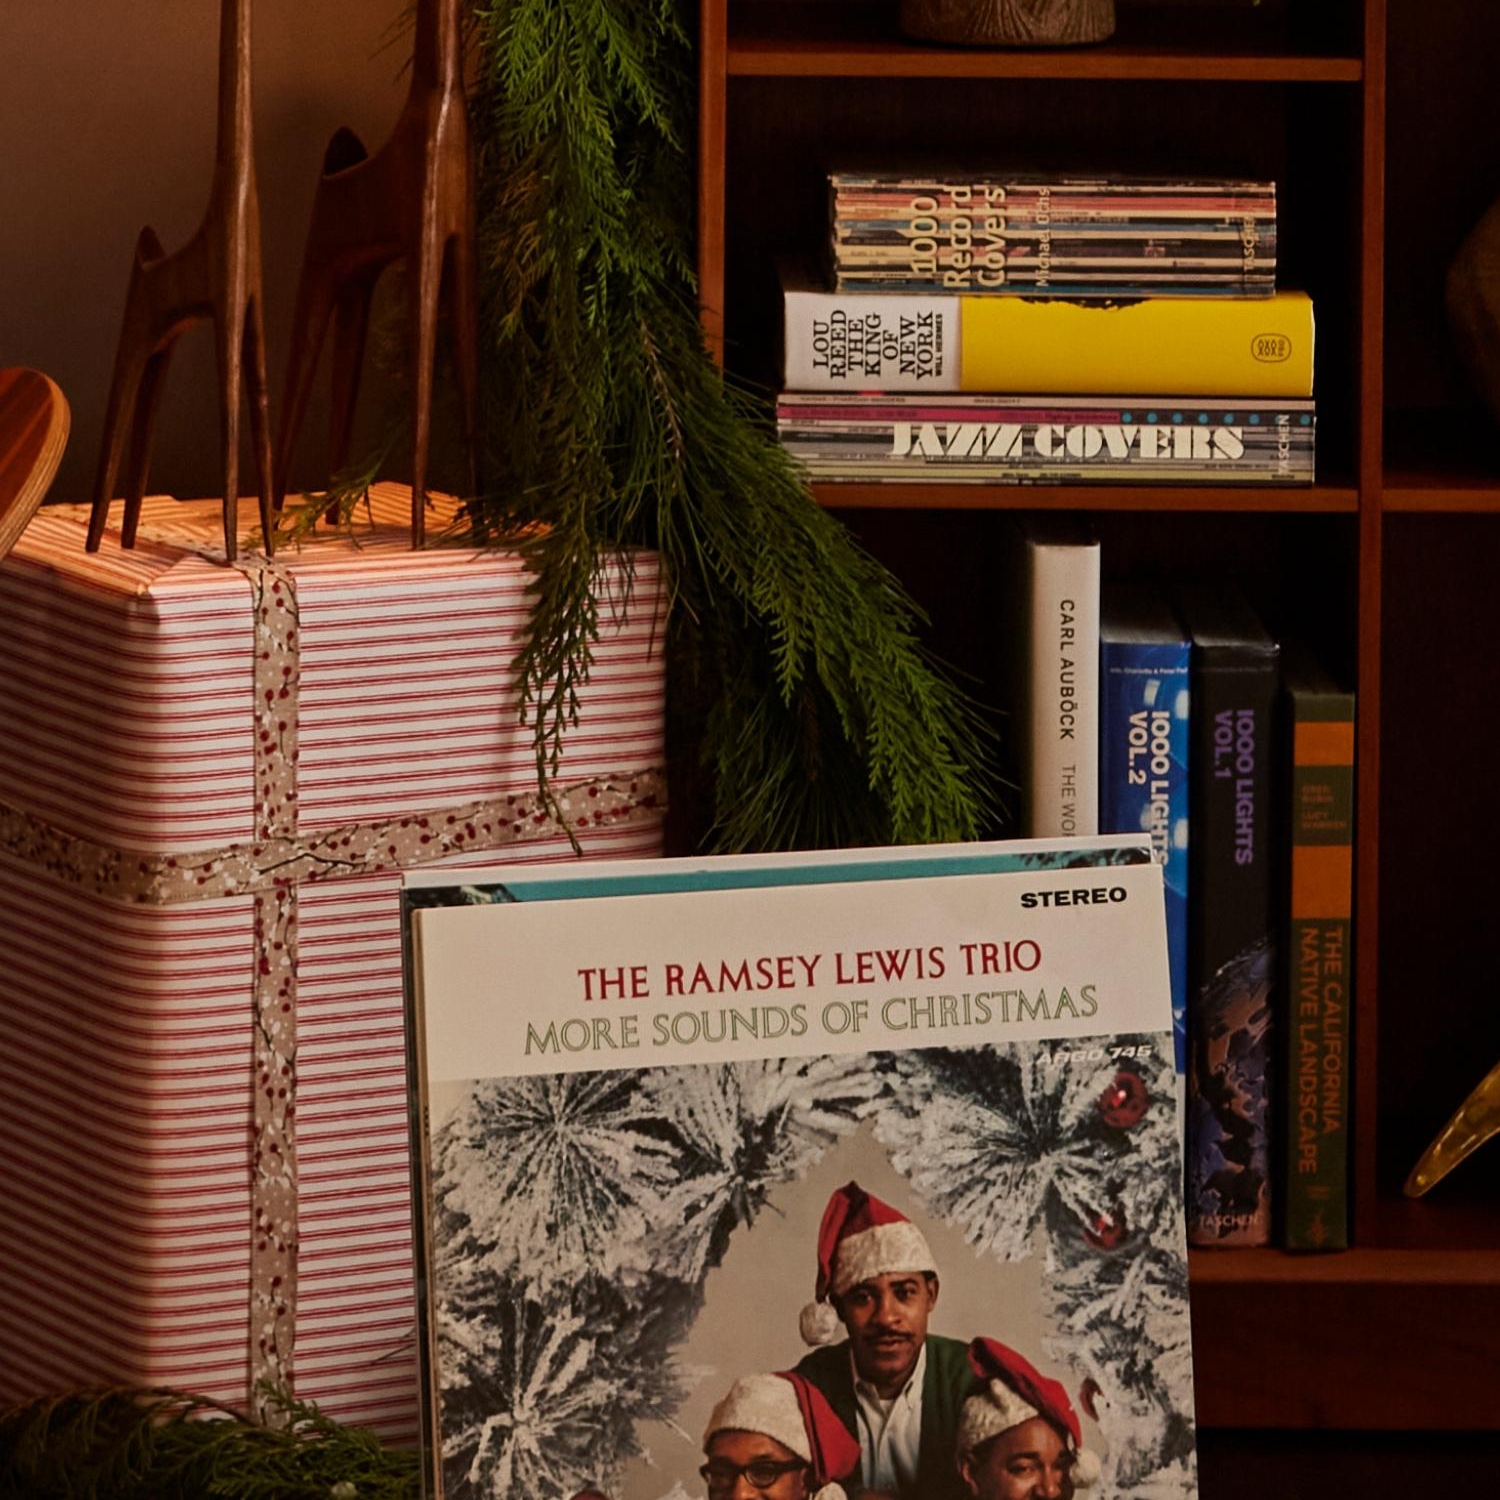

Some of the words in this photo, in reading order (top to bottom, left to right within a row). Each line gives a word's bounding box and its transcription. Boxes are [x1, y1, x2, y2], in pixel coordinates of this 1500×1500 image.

[910, 195, 938, 274] 1000
[943, 185, 971, 288] Record
[977, 186, 1006, 288] Covers
[1036, 187, 1050, 225] Ochs
[1036, 228, 1050, 288] Michael
[812, 319, 829, 368] LOU
[830, 309, 846, 379] REED
[848, 319, 863, 371] THE
[865, 312, 881, 377] KING
[883, 329, 898, 360] OF
[900, 315, 916, 375] NEW
[917, 311, 933, 380] YORK
[887, 422, 1024, 458] JAZZ
[1034, 424, 1245, 460] COVERS
[1279, 413, 1290, 475] TASCHEN
[1059, 599, 1075, 651] CARL
[1059, 657, 1078, 740] AUBÖCK
[1150, 710, 1171, 776] 1000
[1235, 709, 1255, 774] 1000
[1061, 764, 1076, 798] THE
[1149, 779, 1170, 867] LIGHTS
[1234, 778, 1254, 865] LIGHTS
[1020, 886, 1128, 909] STEREO
[577, 965, 650, 1001] THE
[664, 953, 823, 997] RAMSEY
[834, 946, 946, 985] LEWIS
[960, 939, 1042, 975] TRIO
[1299, 927, 1319, 1017] NATIVE
[1323, 927, 1343, 975] THE
[523, 1014, 641, 1056] MORE
[652, 1003, 809, 1047] SOUNDS
[821, 1000, 869, 1035] OF
[880, 984, 1099, 1031] CHRISTMAS
[1108, 1044, 1153, 1060] 745
[1321, 982, 1342, 1135] CALIFORNIA
[1297, 1023, 1318, 1174] LANDSCAPE
